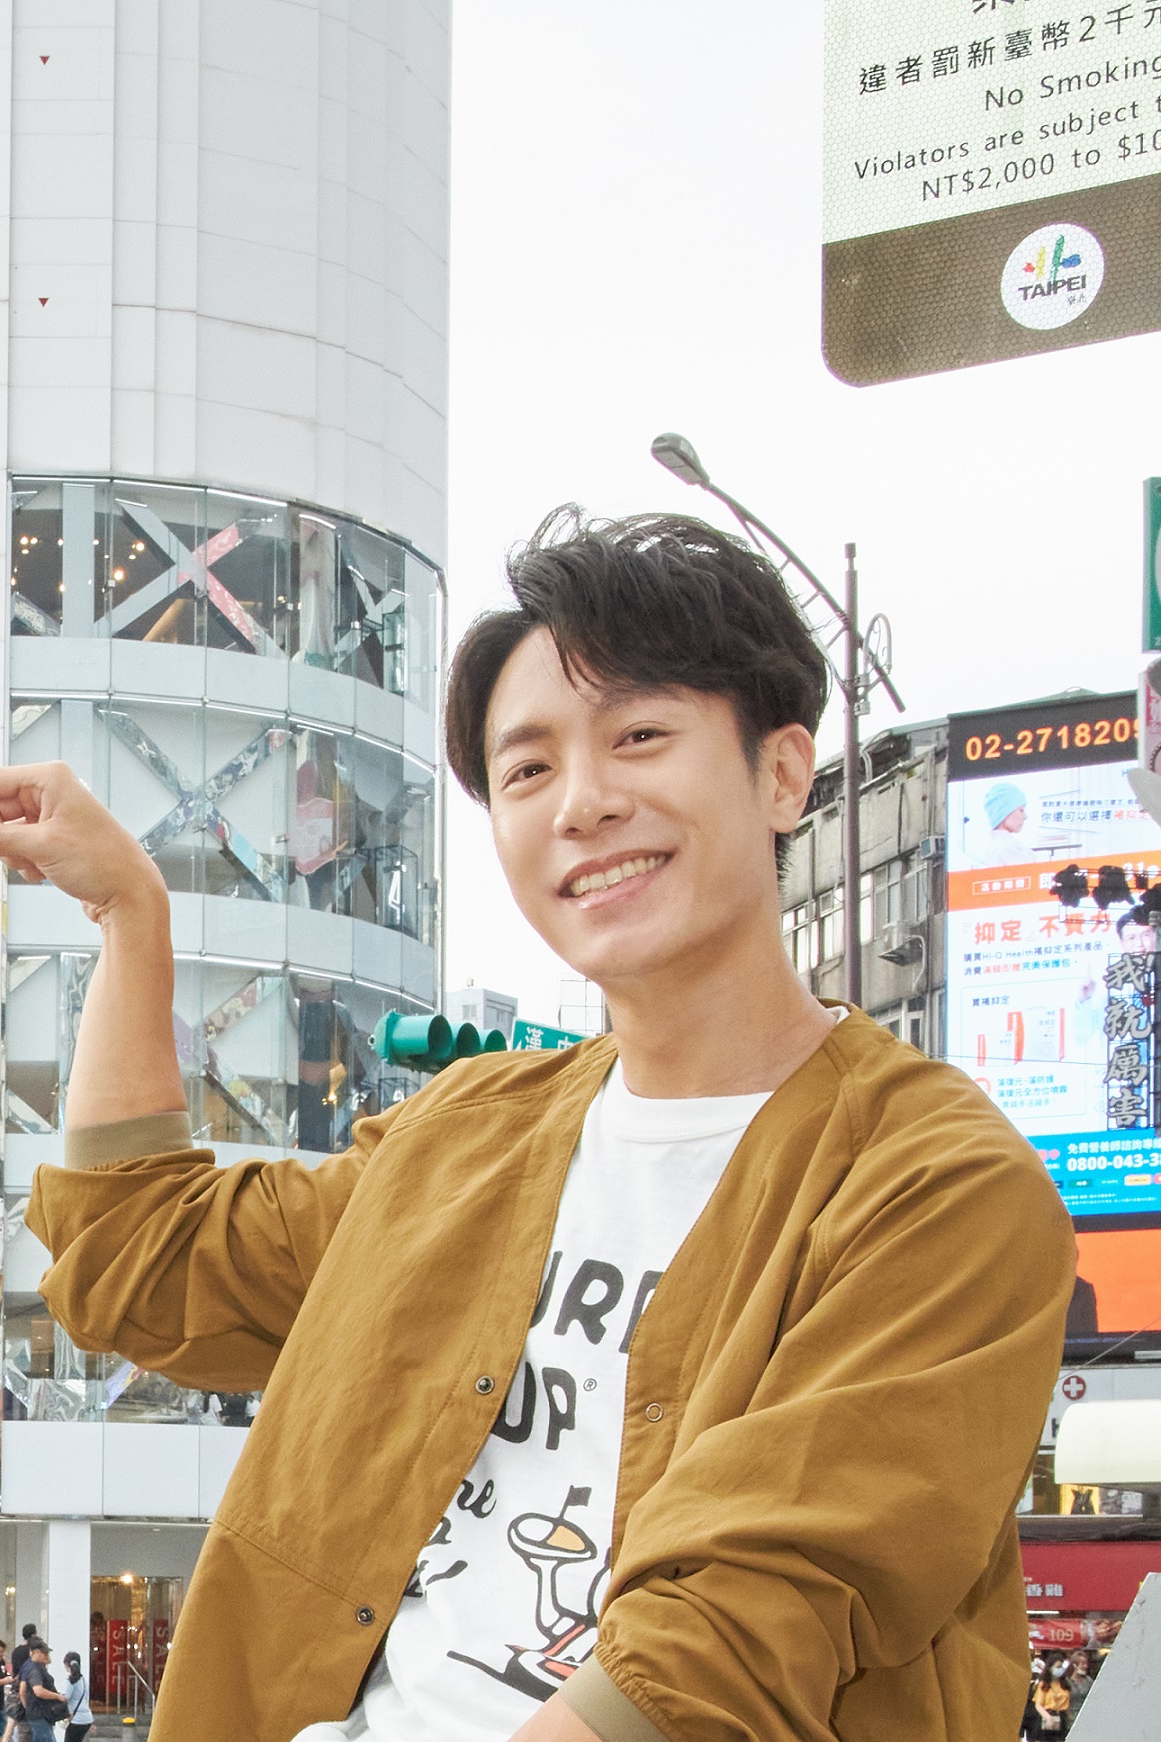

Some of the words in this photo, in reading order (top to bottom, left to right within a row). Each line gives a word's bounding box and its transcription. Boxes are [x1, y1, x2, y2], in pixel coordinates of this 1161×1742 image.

[985, 86, 1024, 111] No
[854, 141, 970, 180] Violators
[984, 129, 1024, 151] are
[1039, 101, 1139, 140] subject
[922, 153, 1055, 201] NT$2,000
[1071, 149, 1101, 169] to
[1018, 275, 1087, 301] TAIPEI
[1067, 1152, 1161, 1172] 0800-043-3
